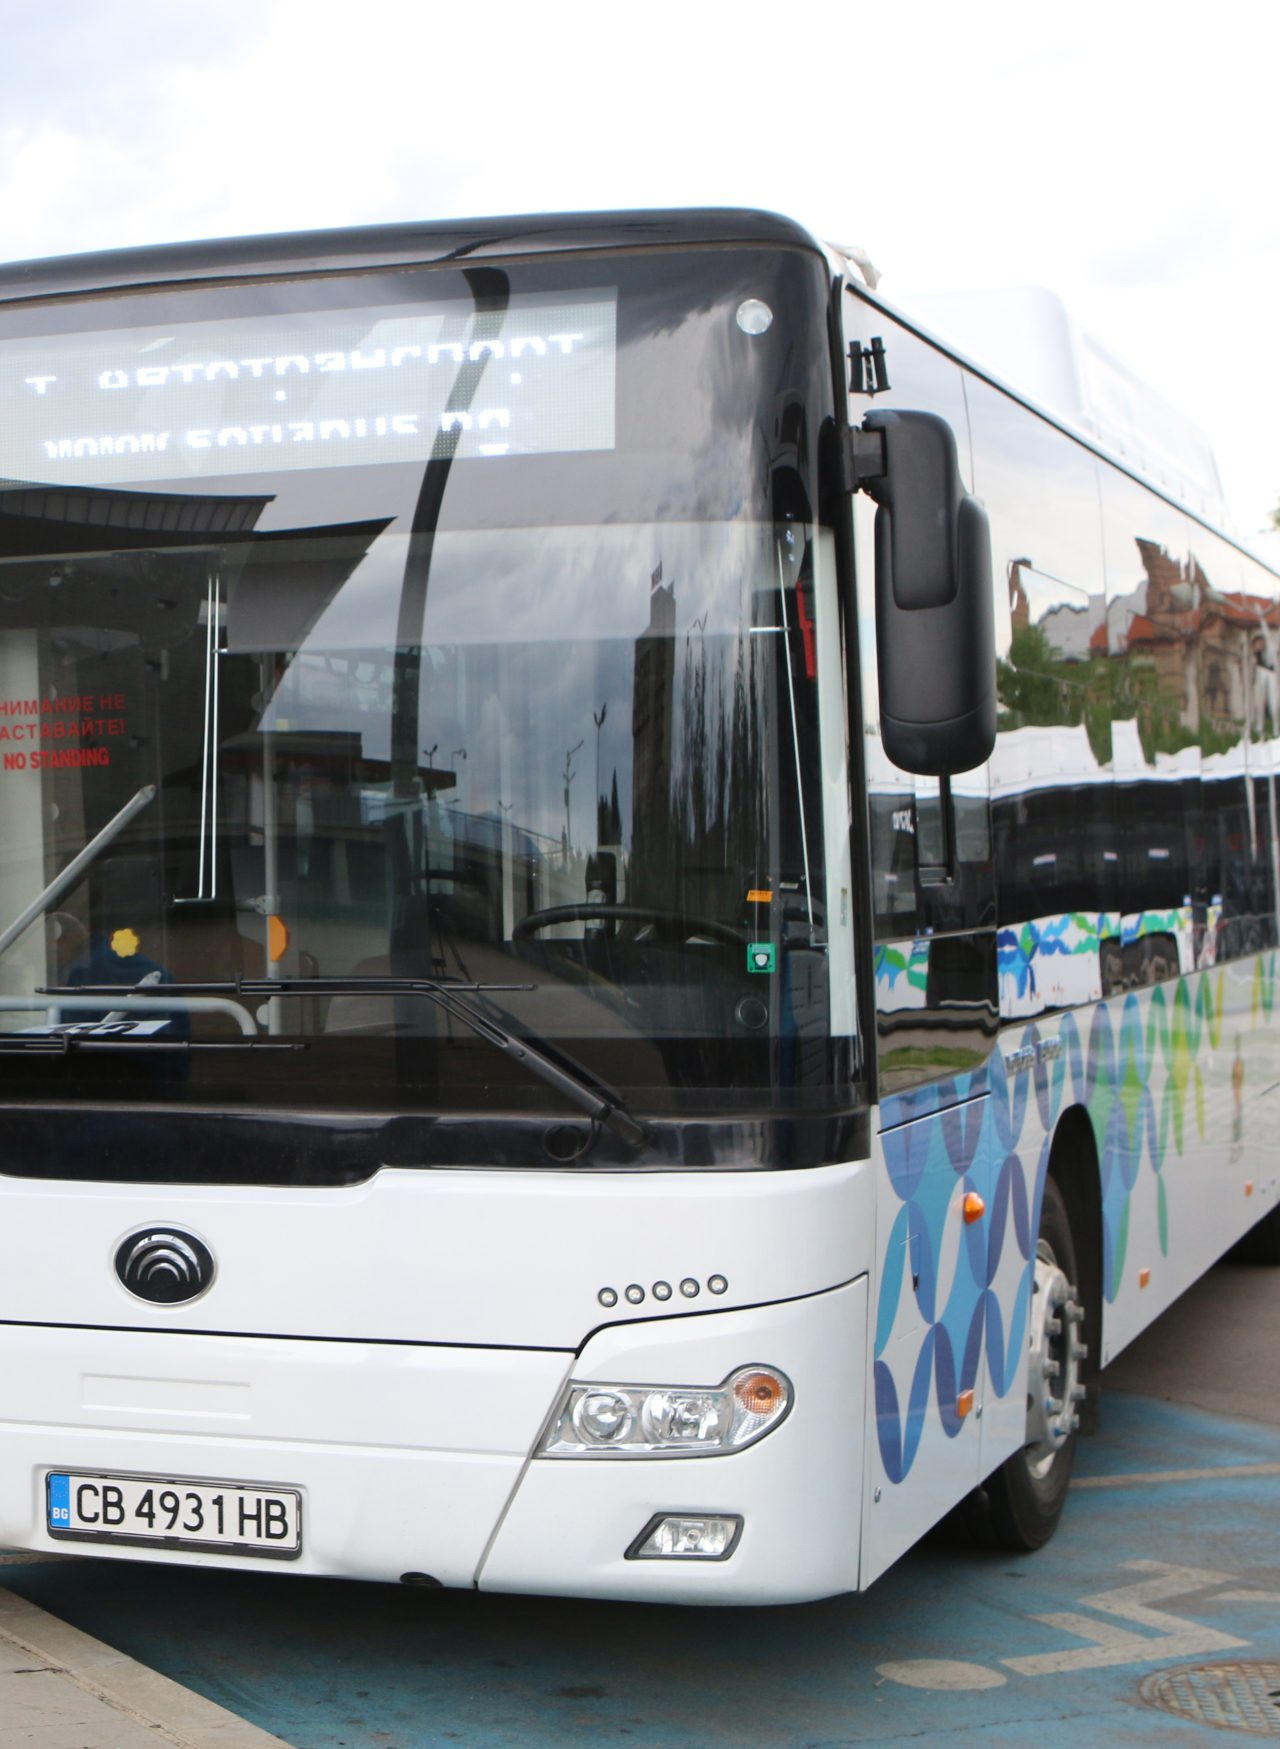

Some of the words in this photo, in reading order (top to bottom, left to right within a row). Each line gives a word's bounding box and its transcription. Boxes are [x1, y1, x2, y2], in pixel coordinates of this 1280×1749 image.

[99, 693, 127, 711] НЕ
[4, 752, 27, 770] NO
[30, 748, 111, 769] STANDING
[53, 1507, 68, 1520] BG
[76, 1484, 125, 1525] CB
[135, 1489, 224, 1535] 4931
[239, 1496, 289, 1540] HB
